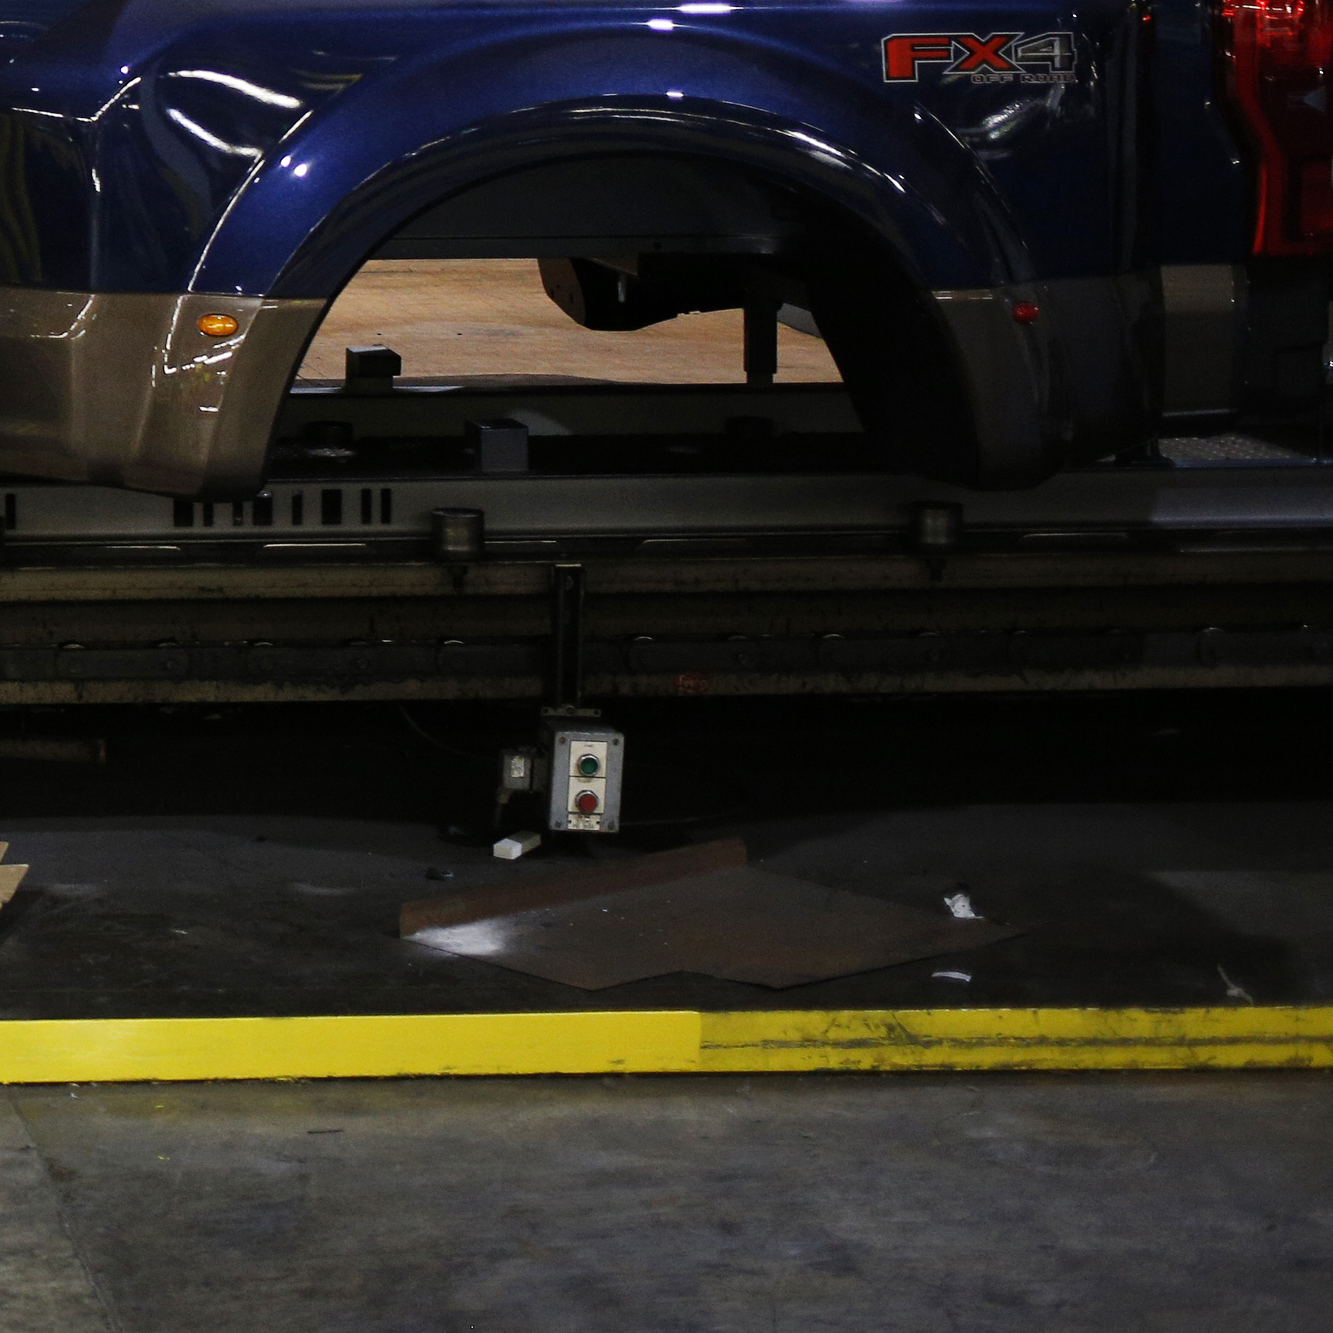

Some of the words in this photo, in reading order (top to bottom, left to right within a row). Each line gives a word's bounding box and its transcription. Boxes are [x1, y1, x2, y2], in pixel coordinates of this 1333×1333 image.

[881, 32, 1077, 83] FX4
[971, 74, 1014, 84] OFF
[1020, 73, 1076, 84] ROAD
